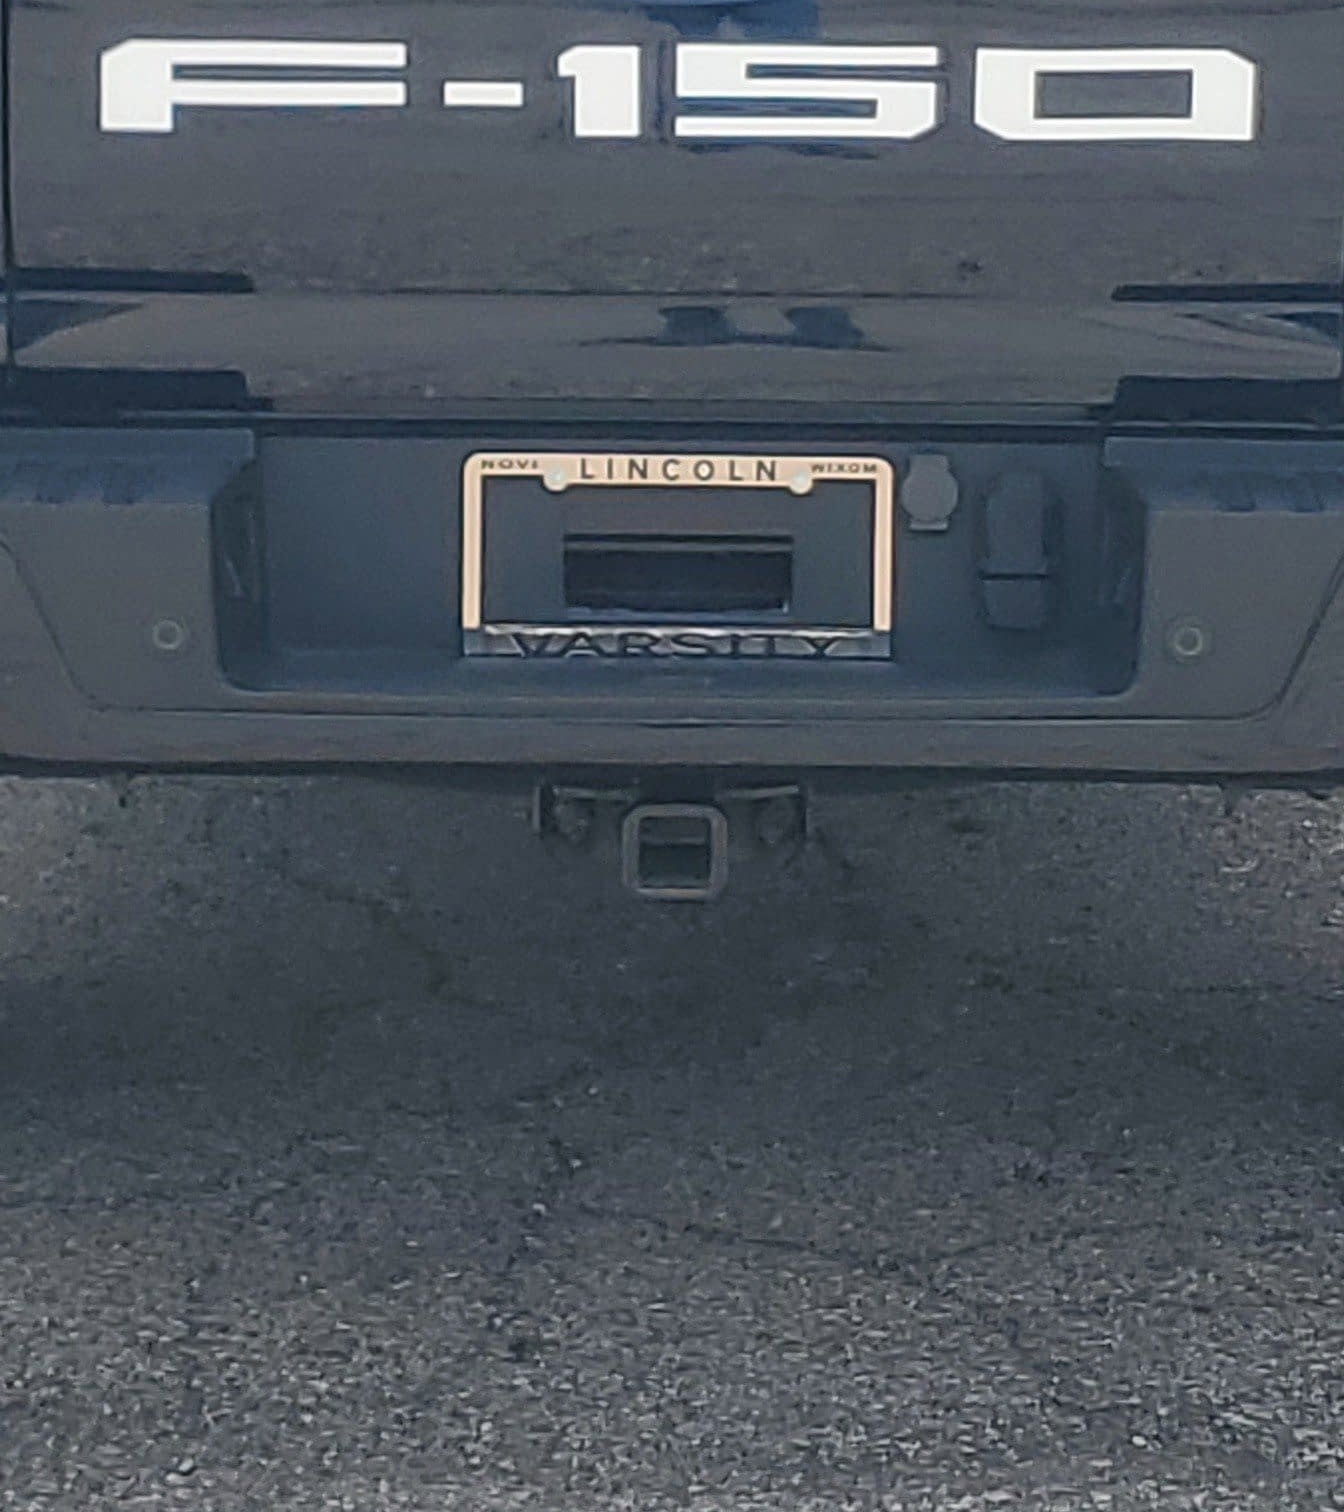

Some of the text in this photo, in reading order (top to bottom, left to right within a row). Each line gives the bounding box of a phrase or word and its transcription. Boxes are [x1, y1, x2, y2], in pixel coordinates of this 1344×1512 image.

[99, 40, 1259, 143] F-150
[481, 459, 539, 470] NOVI
[580, 459, 777, 481] LINCOLN
[511, 633, 844, 657] VARSITY
